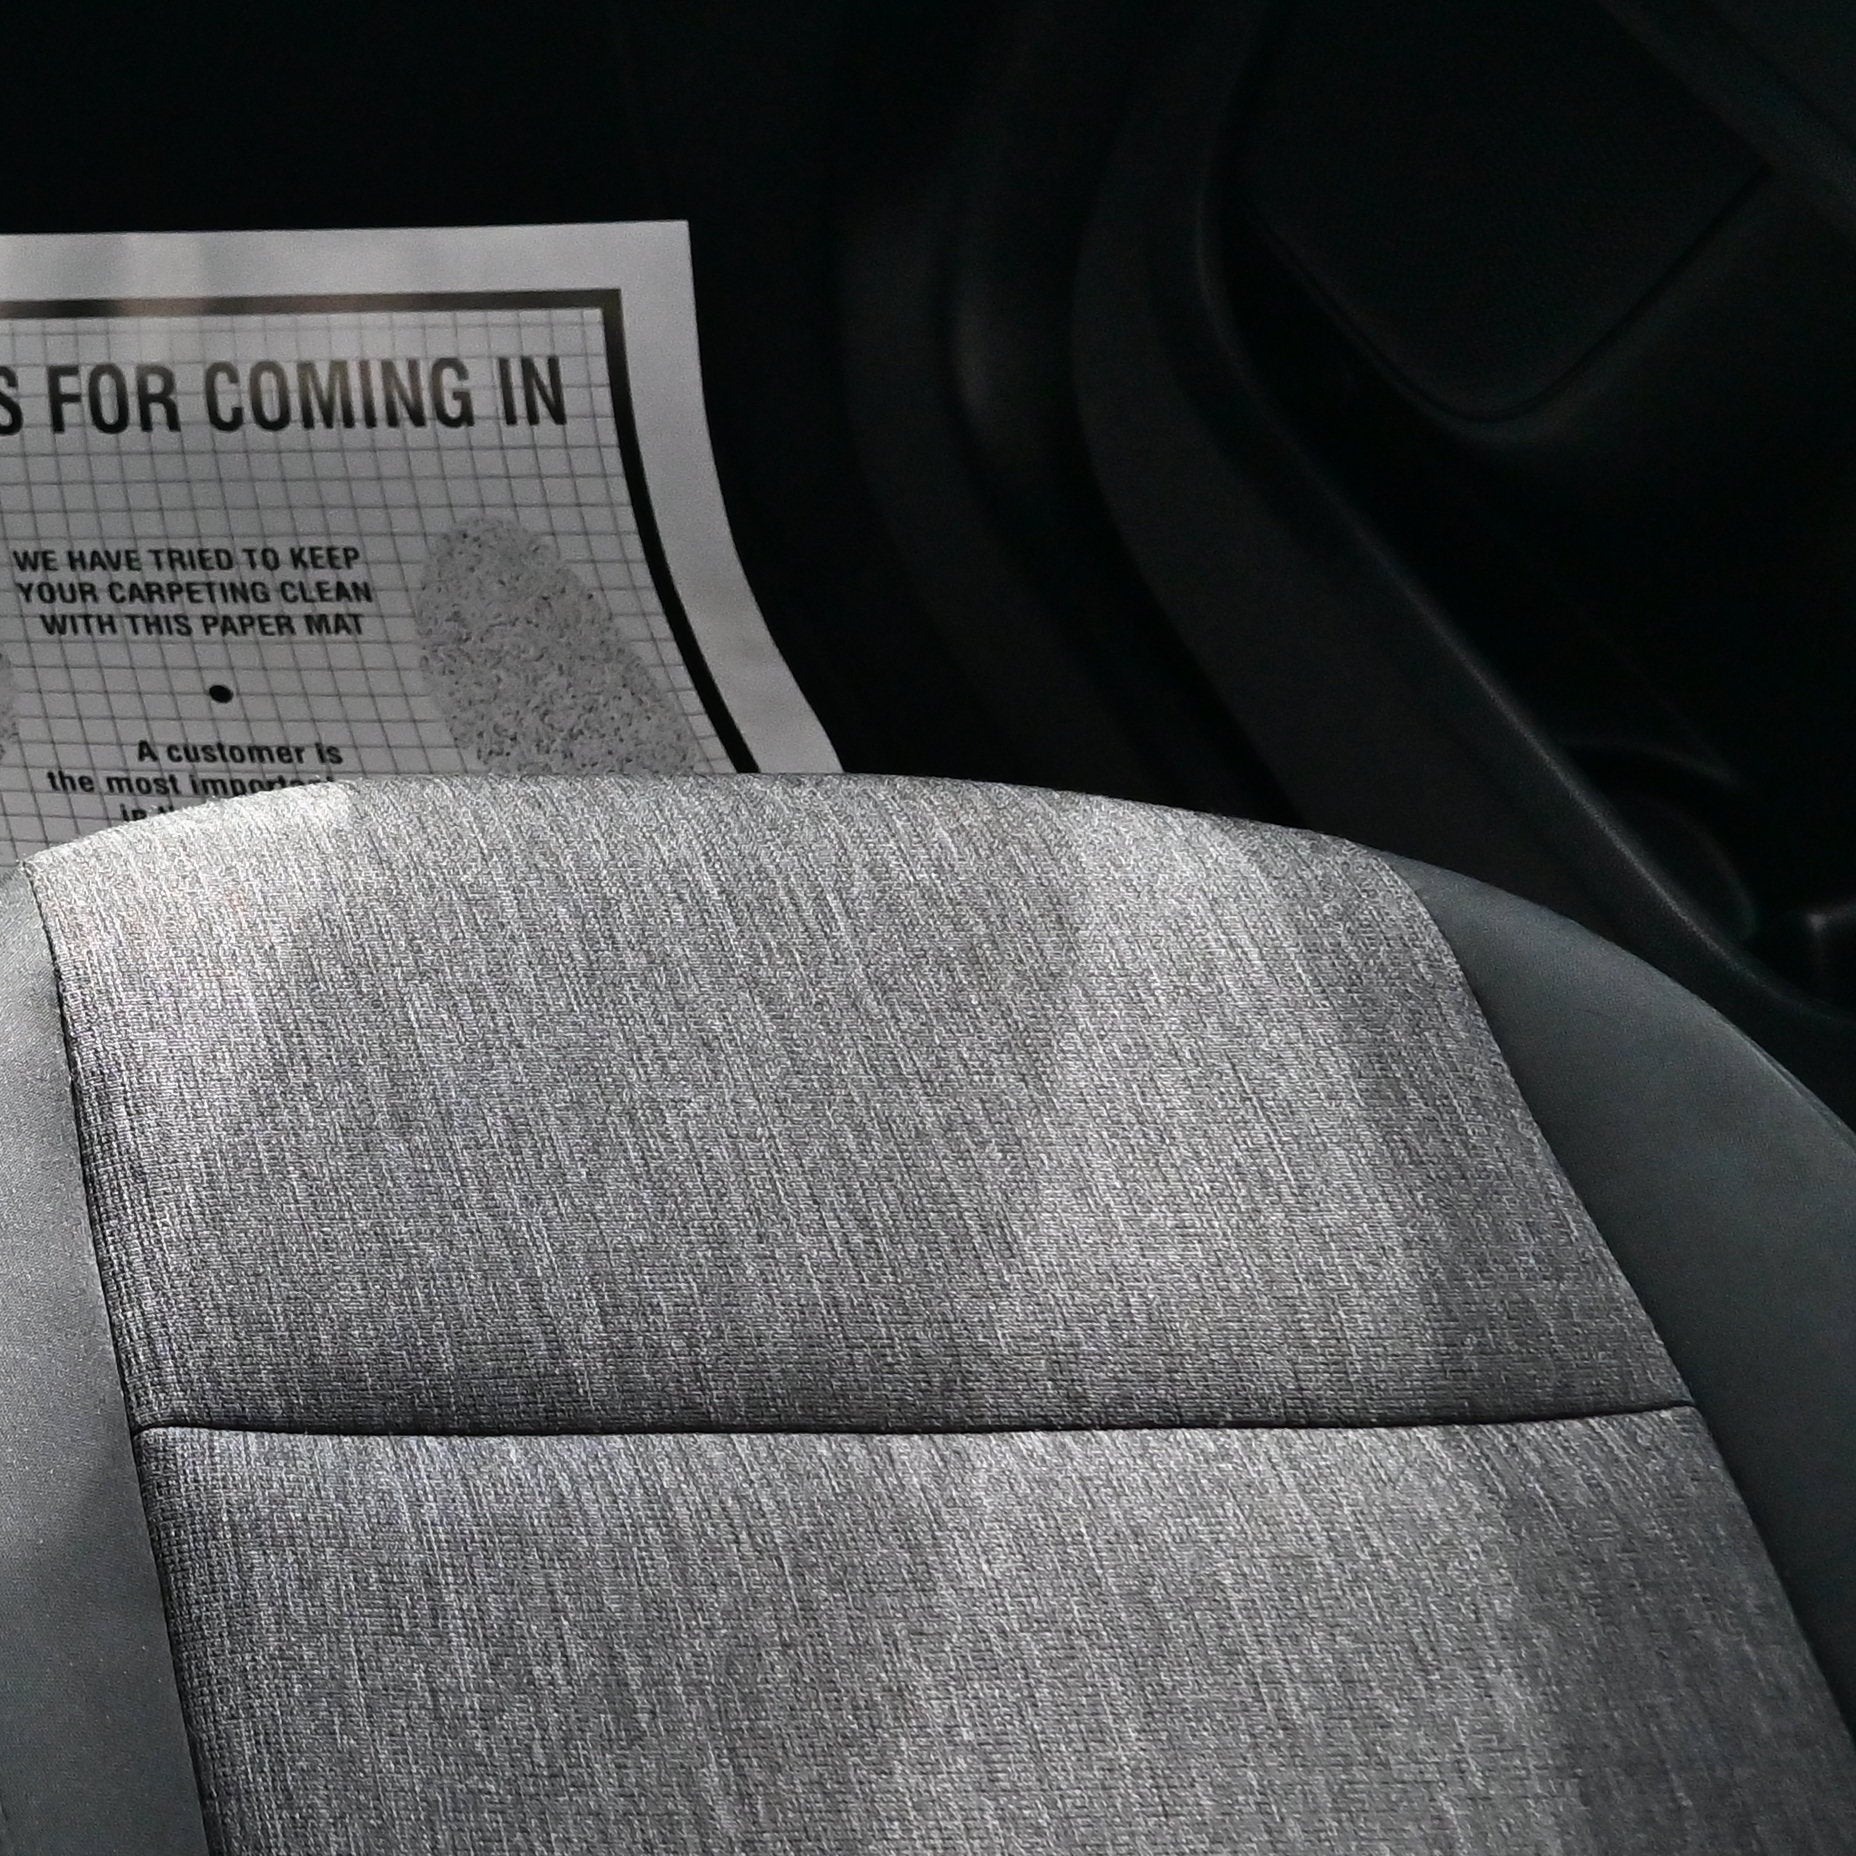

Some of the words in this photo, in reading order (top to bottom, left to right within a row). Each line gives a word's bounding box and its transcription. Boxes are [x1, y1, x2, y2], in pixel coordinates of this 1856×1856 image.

[45, 362, 183, 435] FOR
[203, 357, 477, 432] COMING
[496, 355, 569, 427] IN
[12, 549, 59, 572] WE
[66, 548, 143, 572] HAVE
[147, 547, 235, 572] TRIED
[241, 547, 281, 572] TO
[288, 546, 361, 571] KEEP
[14, 581, 100, 604] YOUR
[107, 580, 273, 605] CARPETING
[278, 579, 374, 603] CLEAN
[38, 613, 118, 636] WITH
[124, 613, 193, 637] THIS
[199, 613, 297, 637] PAPER
[302, 612, 365, 637] MAT
[137, 739, 159, 763] A
[166, 742, 305, 765] customer
[314, 742, 344, 765] is
[46, 769, 95, 794] the
[106, 773, 180, 796] most
